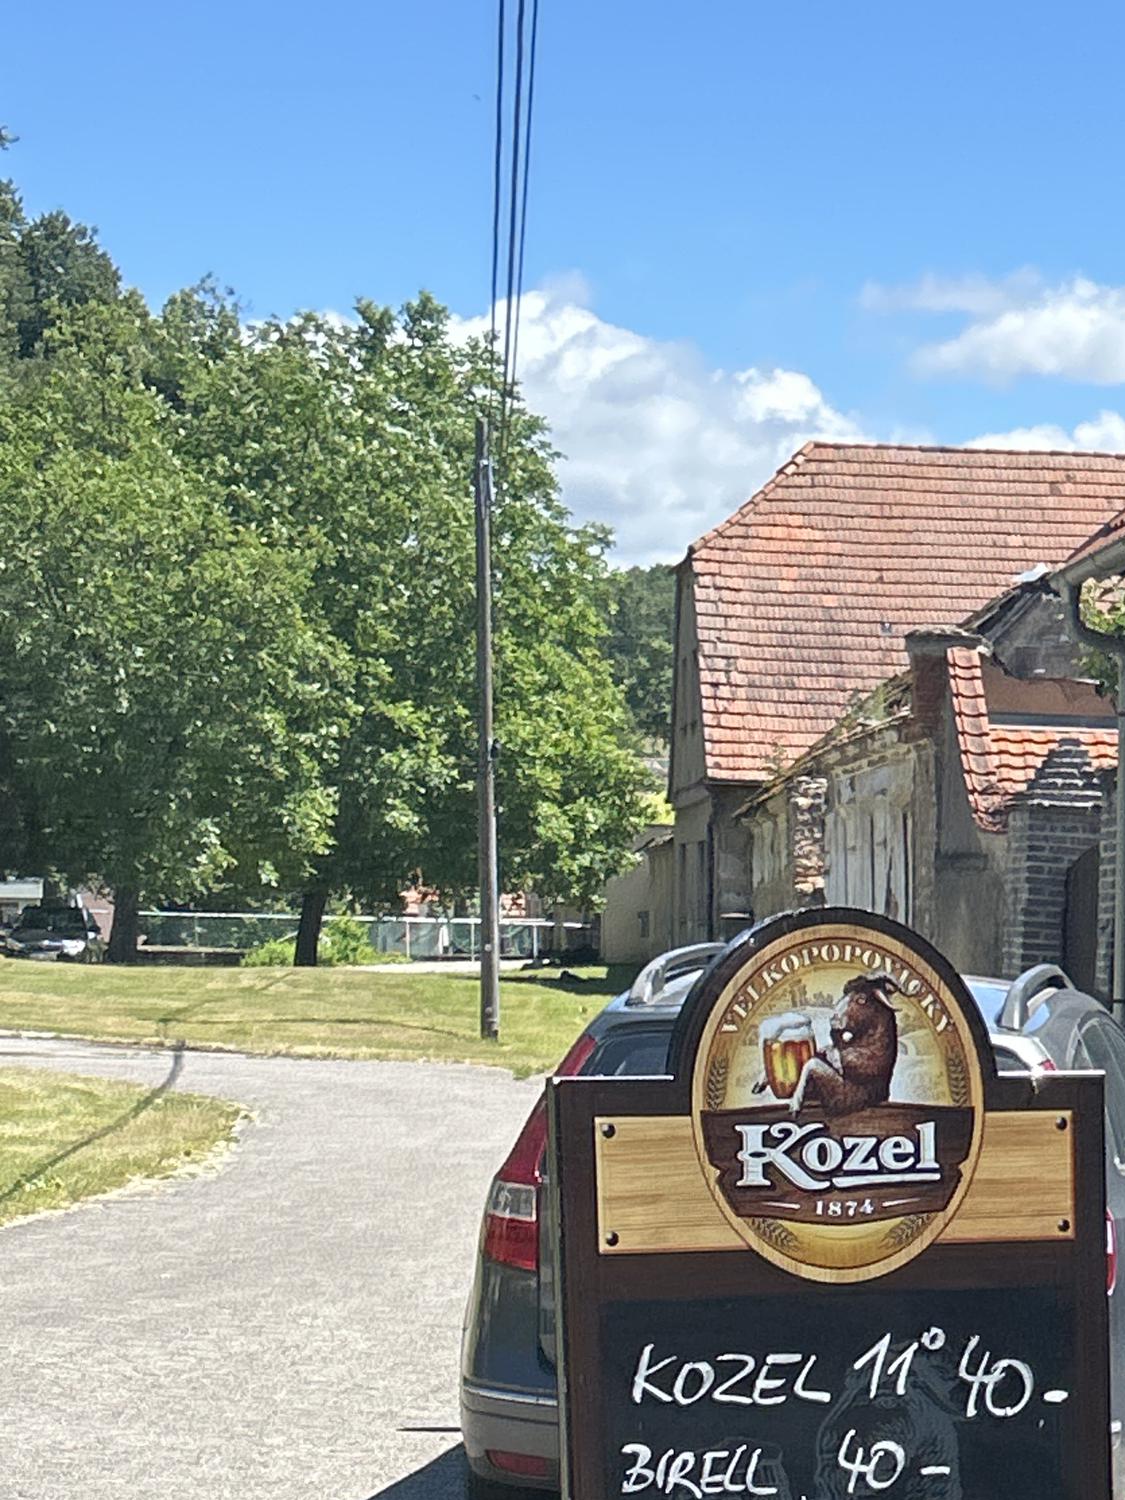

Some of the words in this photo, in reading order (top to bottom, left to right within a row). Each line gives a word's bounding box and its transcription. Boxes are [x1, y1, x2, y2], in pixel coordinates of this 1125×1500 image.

[735, 1121, 942, 1191] Kozel
[815, 1198, 874, 1217] 1874
[632, 1343, 831, 1404] KOZEL
[621, 1444, 778, 1499] BIRELL
